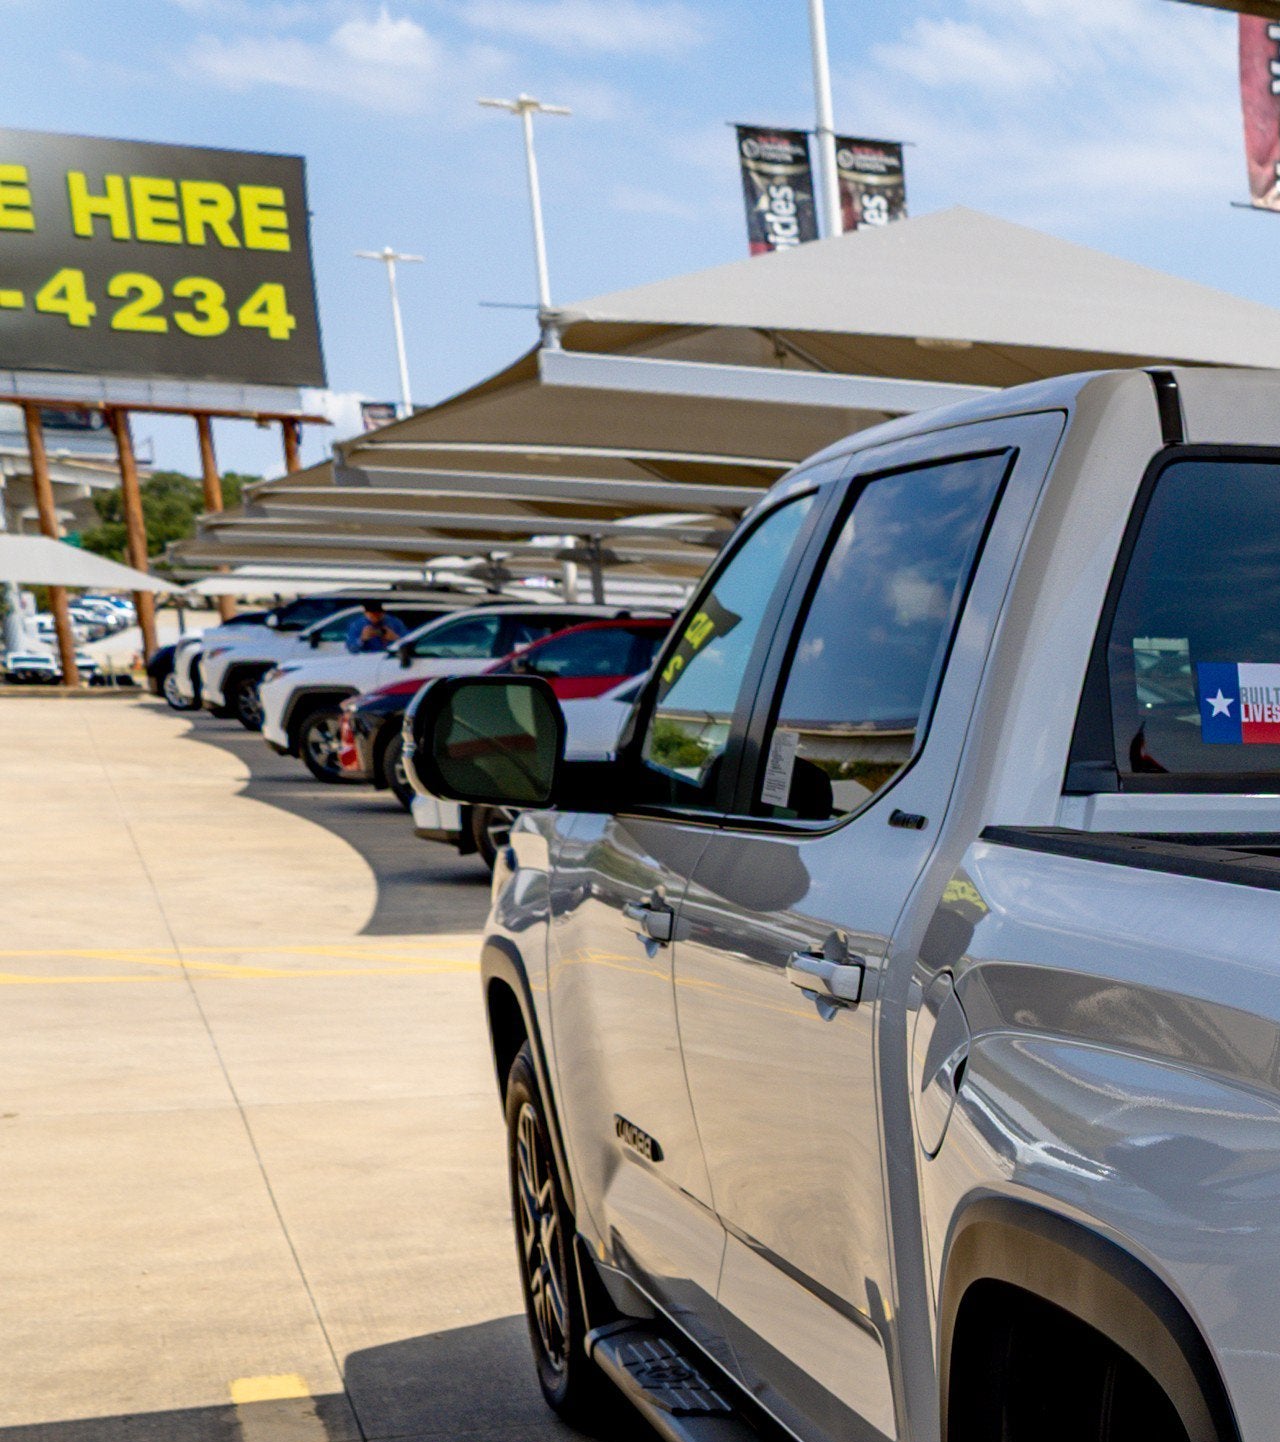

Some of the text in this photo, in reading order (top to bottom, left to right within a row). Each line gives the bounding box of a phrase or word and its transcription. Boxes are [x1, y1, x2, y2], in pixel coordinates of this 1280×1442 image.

[66, 171, 291, 252] HERE
[0, 268, 297, 340] -4234
[1240, 687, 1280, 704] BUILT
[1241, 704, 1280, 723] LIVES
